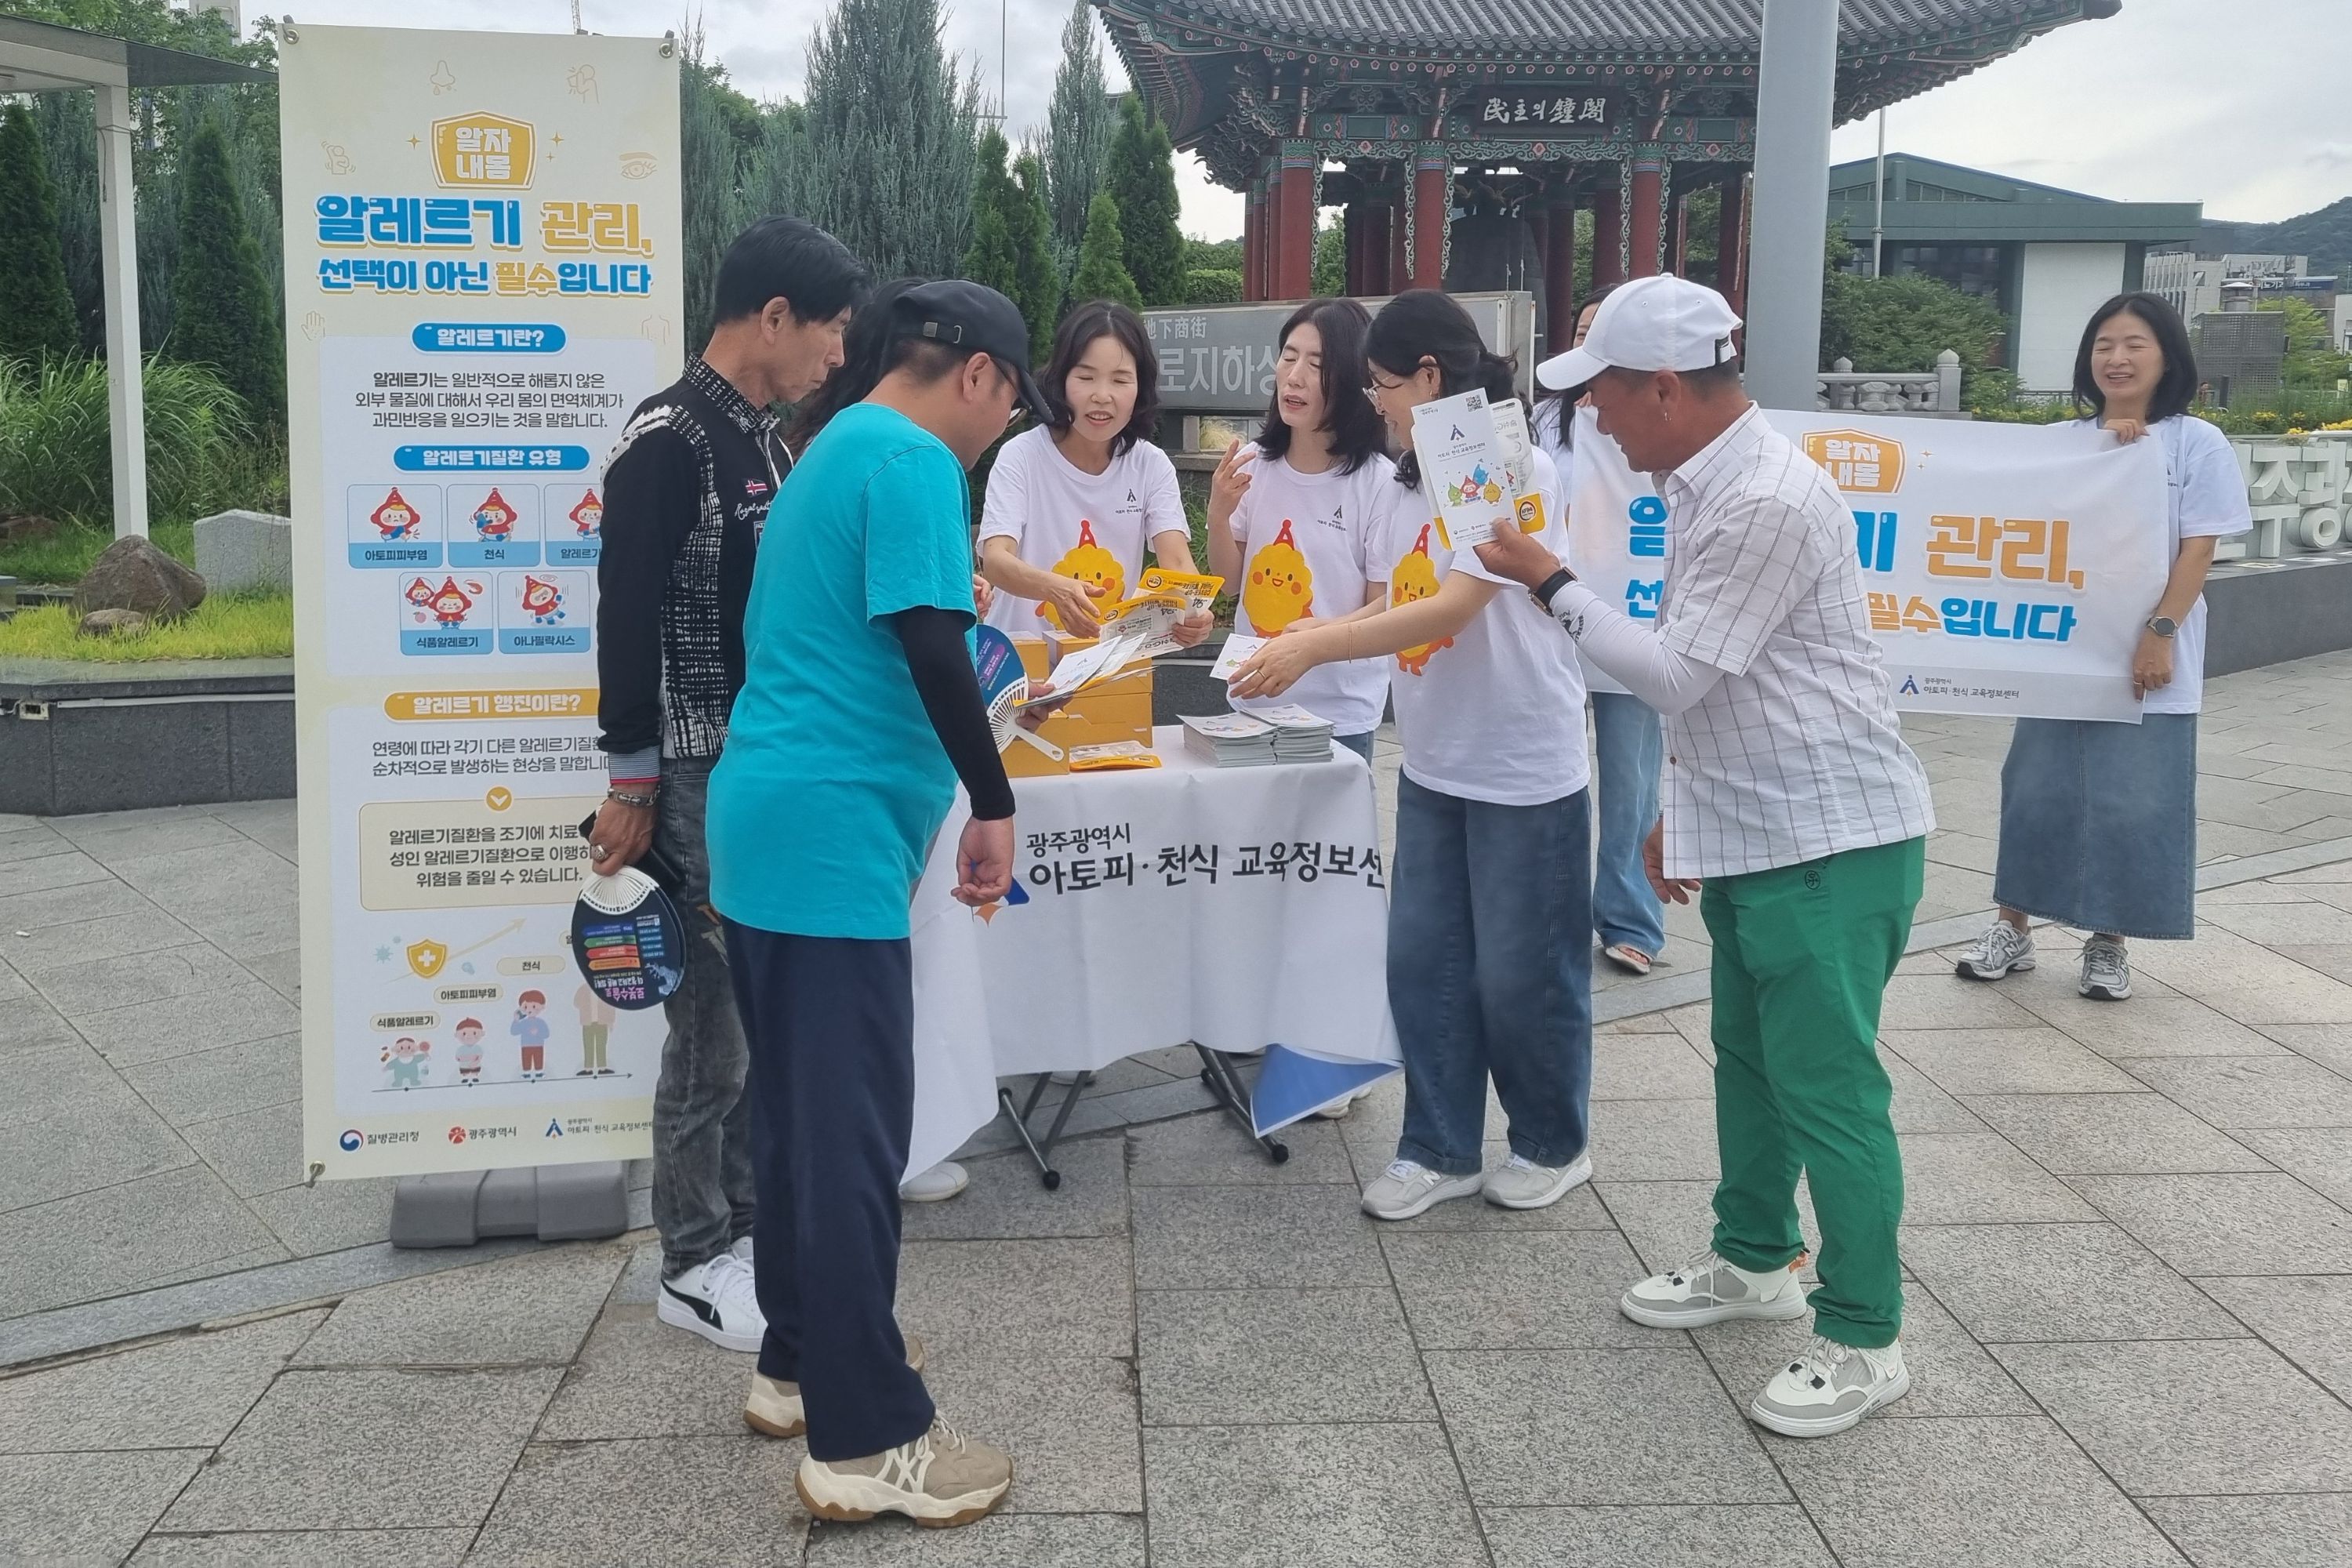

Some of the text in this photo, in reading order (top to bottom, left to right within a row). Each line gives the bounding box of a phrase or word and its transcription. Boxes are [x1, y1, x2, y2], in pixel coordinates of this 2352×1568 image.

[456, 126, 512, 153] 알자
[456, 154, 511, 180] 내몸
[316, 195, 655, 256] 알레르기 관리,
[318, 258, 652, 296] 선택이 아닌 필수입니다
[437, 328, 545, 347] 알레르기란?
[373, 372, 605, 389] 알레르기는 일반적으로 해롭지 않은
[355, 393, 624, 409] 외부 물질에 대해서 우리 몸의 면역체계가
[372, 412, 608, 429] 과민반응을 일으키는 것을 말합니다.
[423, 450, 562, 466] 알레르기질환 유형
[1824, 439, 1881, 463] 알자
[1824, 462, 1881, 488] 내몸
[365, 549, 427, 561] 아토피피부염
[485, 549, 505, 561] 천식
[1926, 514, 2086, 591] 관리,
[1867, 592, 2078, 643] 필수입니다
[416, 635, 575, 648] 식품알레르기 아나필락시스
[1970, 688, 2020, 699] 교육정보센터
[414, 694, 581, 714] 알레르기 행진이란?
[372, 741, 417, 757] 연령에
[421, 740, 451, 756] 따라
[454, 739, 483, 756] 각기
[487, 738, 516, 754] 다른
[372, 760, 447, 777] 순차적으로
[451, 758, 509, 775] 발생하는
[513, 757, 557, 773] 현상을
[389, 824, 579, 846] 알레르기질환을 조기에 치료
[1026, 822, 1131, 858] 광주광역시
[390, 850, 421, 867] 성인
[424, 846, 545, 866] 알레르기질환으로
[416, 866, 583, 888] 위험을 줄일 수 있습니다.
[522, 960, 541, 971] 천식
[441, 987, 496, 1000] 아토피피부염
[376, 1016, 434, 1028] 식품알레르기
[367, 1131, 419, 1145] 질병관리청
[469, 1126, 517, 1141] 광주광역시
